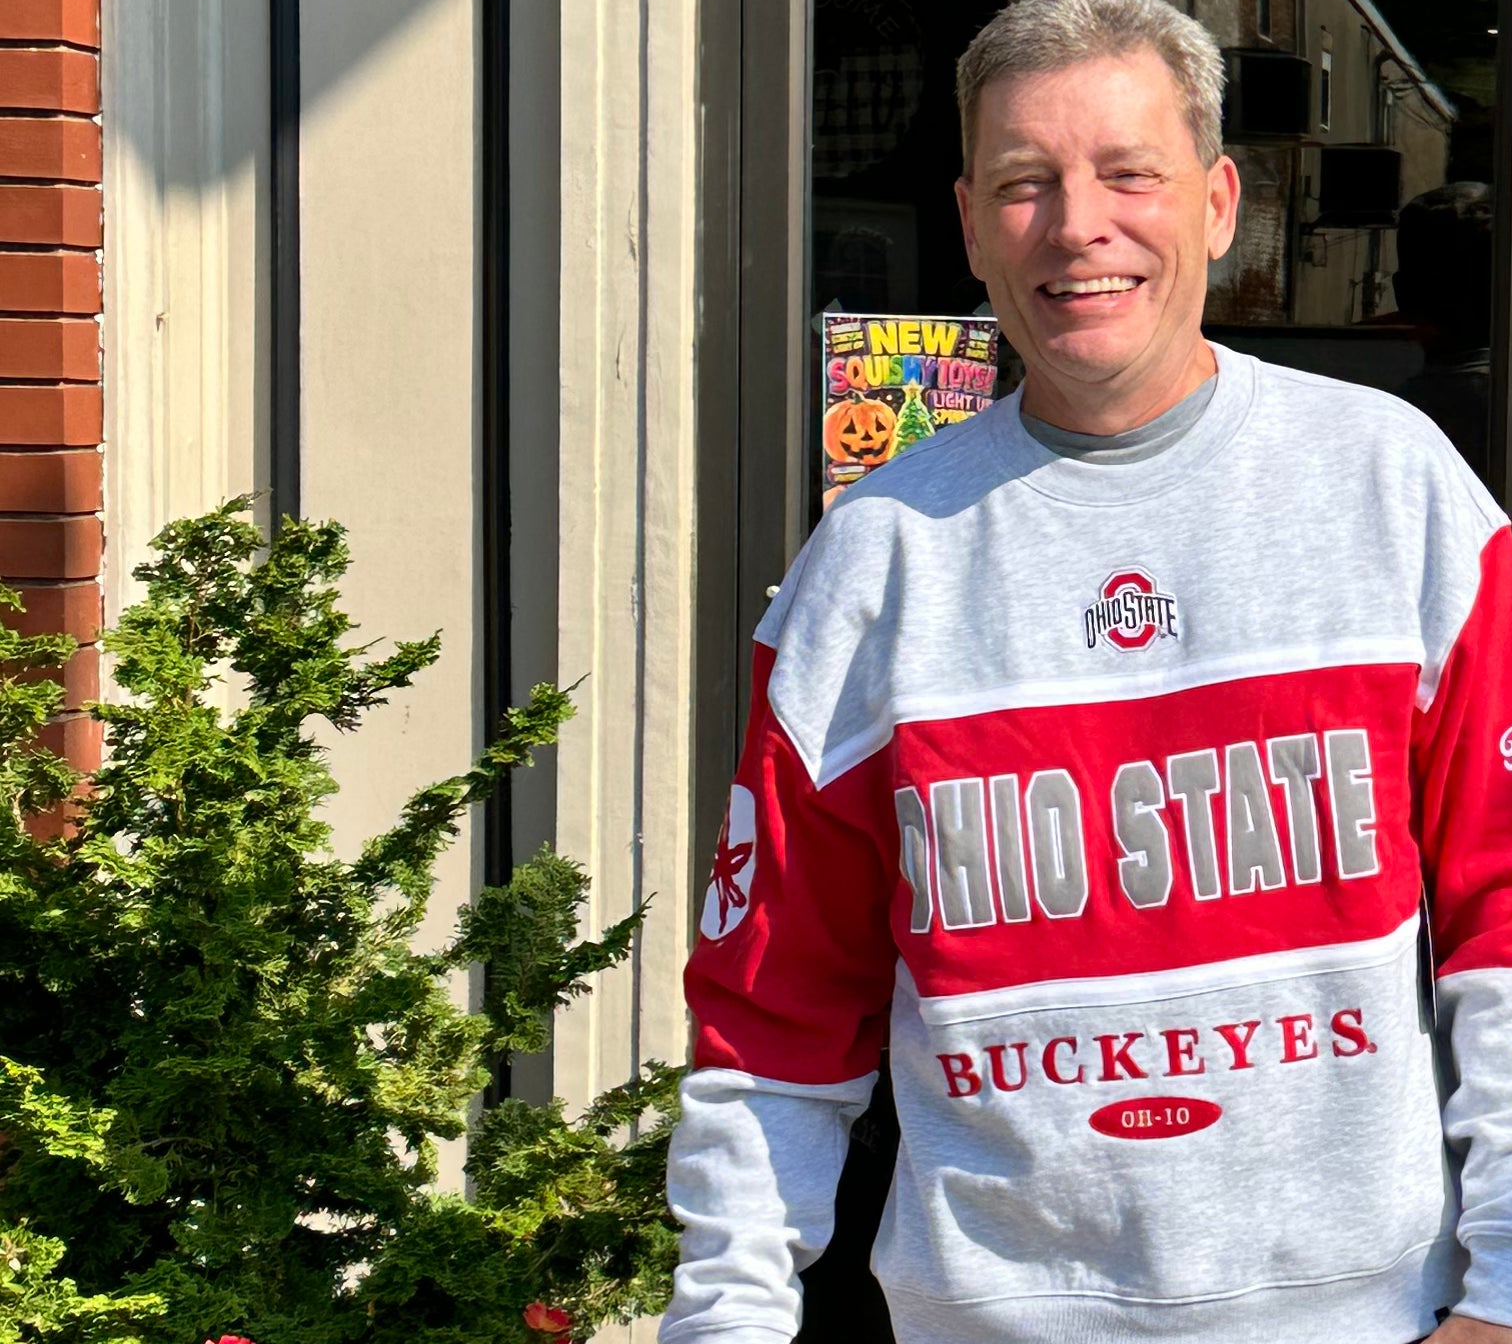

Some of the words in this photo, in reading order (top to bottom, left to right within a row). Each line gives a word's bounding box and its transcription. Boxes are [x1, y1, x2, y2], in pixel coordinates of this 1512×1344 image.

[868, 321, 962, 356] NEW
[828, 355, 939, 396] SQUISHY
[933, 393, 973, 408] LIGHT
[1085, 598, 1122, 648] OHIO
[1123, 592, 1178, 638] STATE
[1112, 729, 1380, 908] STATE
[1121, 1107, 1190, 1128] OH-10
